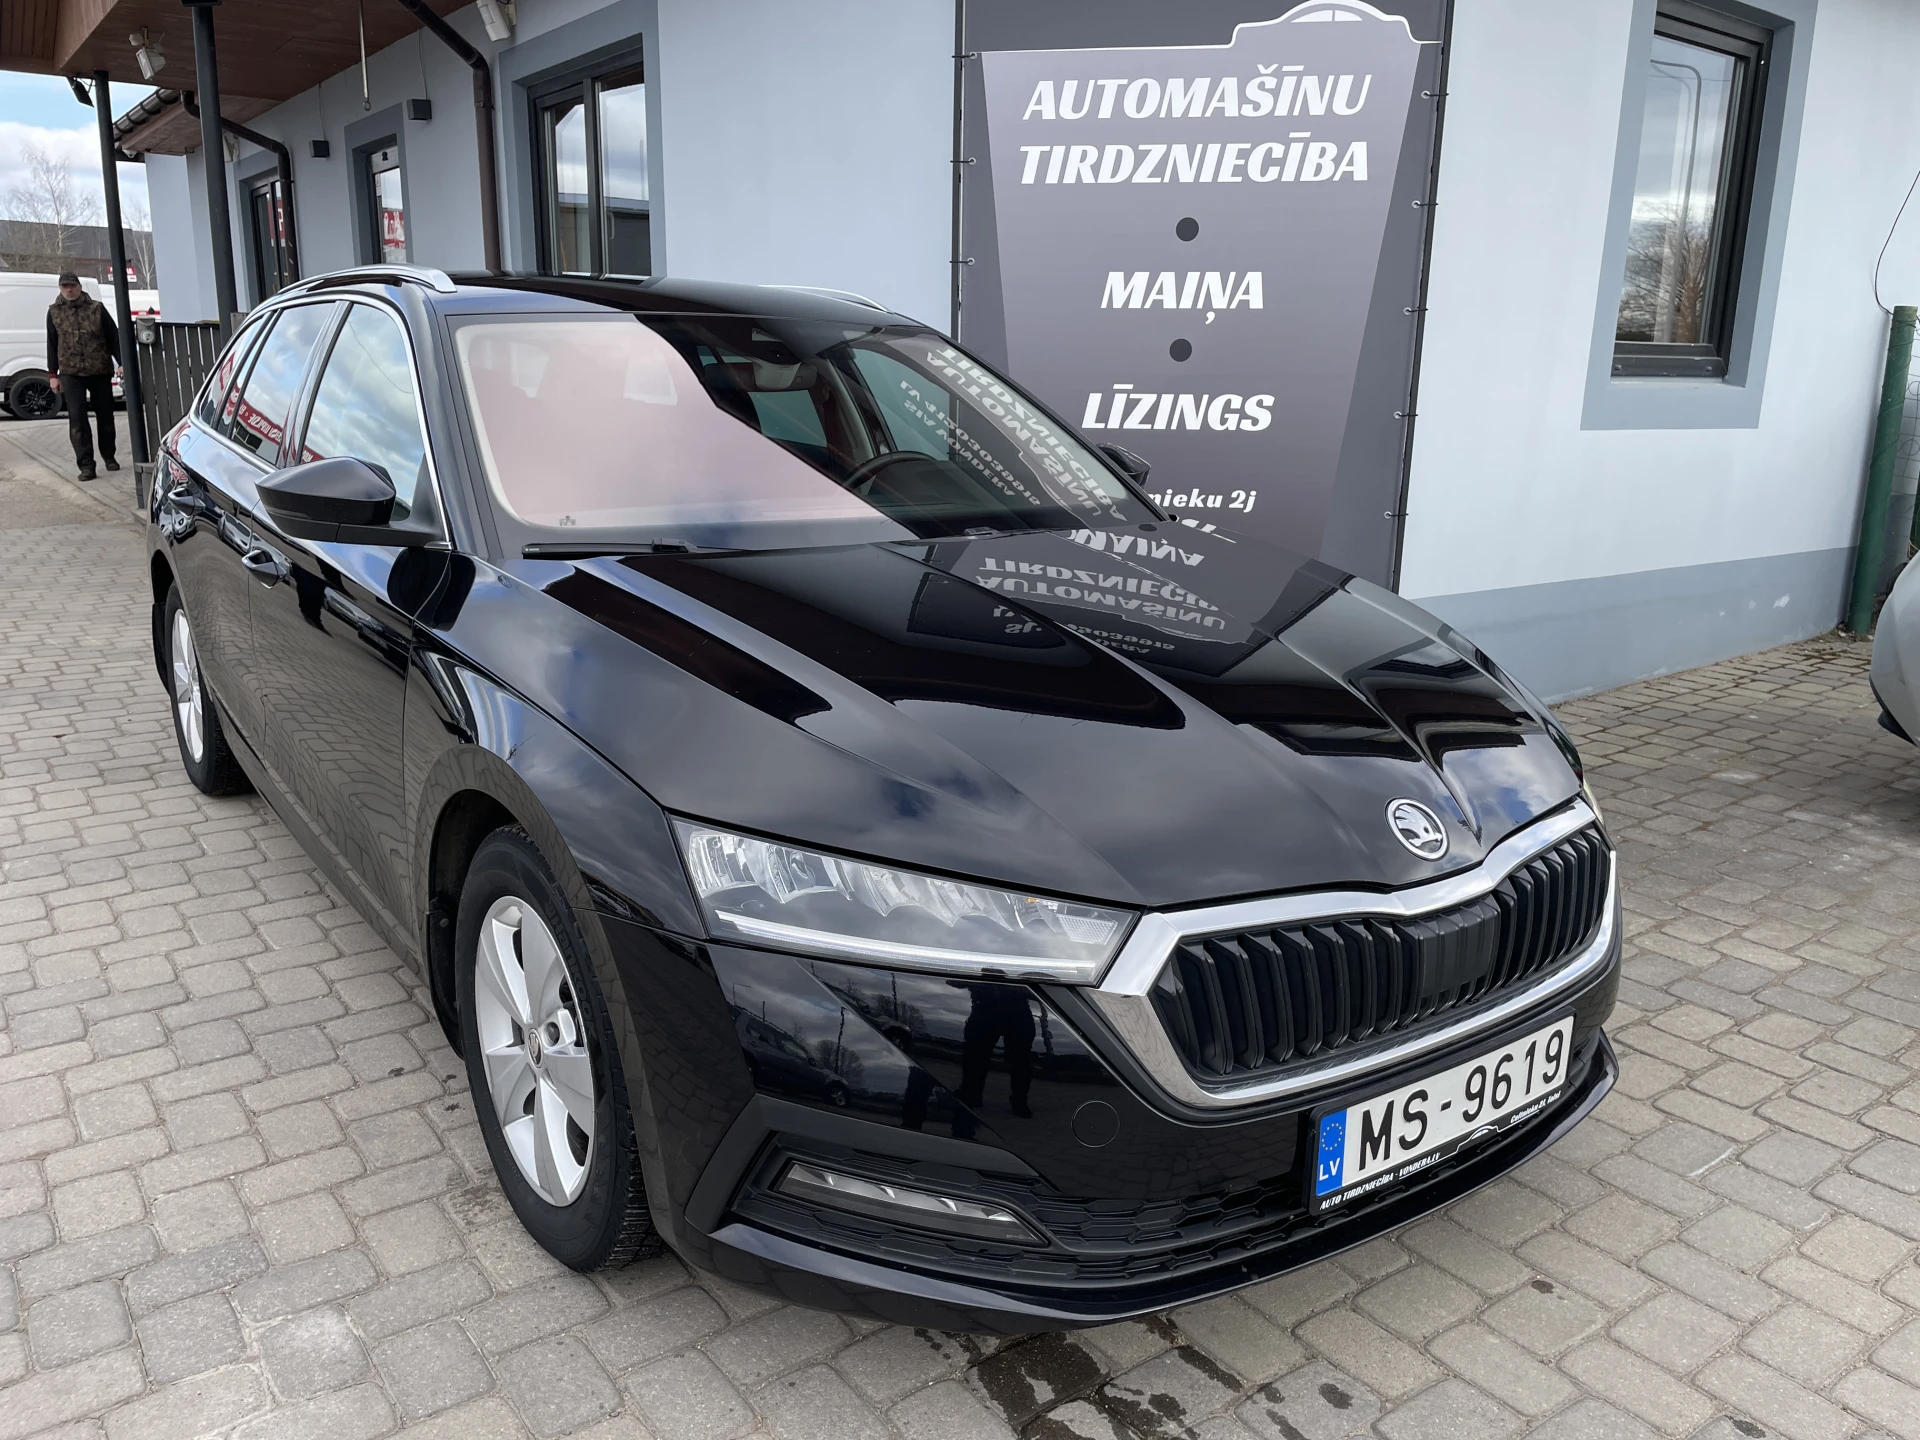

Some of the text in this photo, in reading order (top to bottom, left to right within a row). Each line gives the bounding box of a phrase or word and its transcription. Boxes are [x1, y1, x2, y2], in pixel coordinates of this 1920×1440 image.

[1022, 64, 1372, 120] AUTOMAŠĪNU
[1019, 131, 1369, 184] TIRDZNIECĪBA
[1100, 271, 1264, 325] MAIŅA
[1081, 383, 1275, 432] LĪZINGS
[1228, 490, 1257, 513] 2j
[1358, 1028, 1565, 1171] MS-9619
[1318, 1157, 1341, 1182] LV
[1319, 1194, 1341, 1211] AUTO
